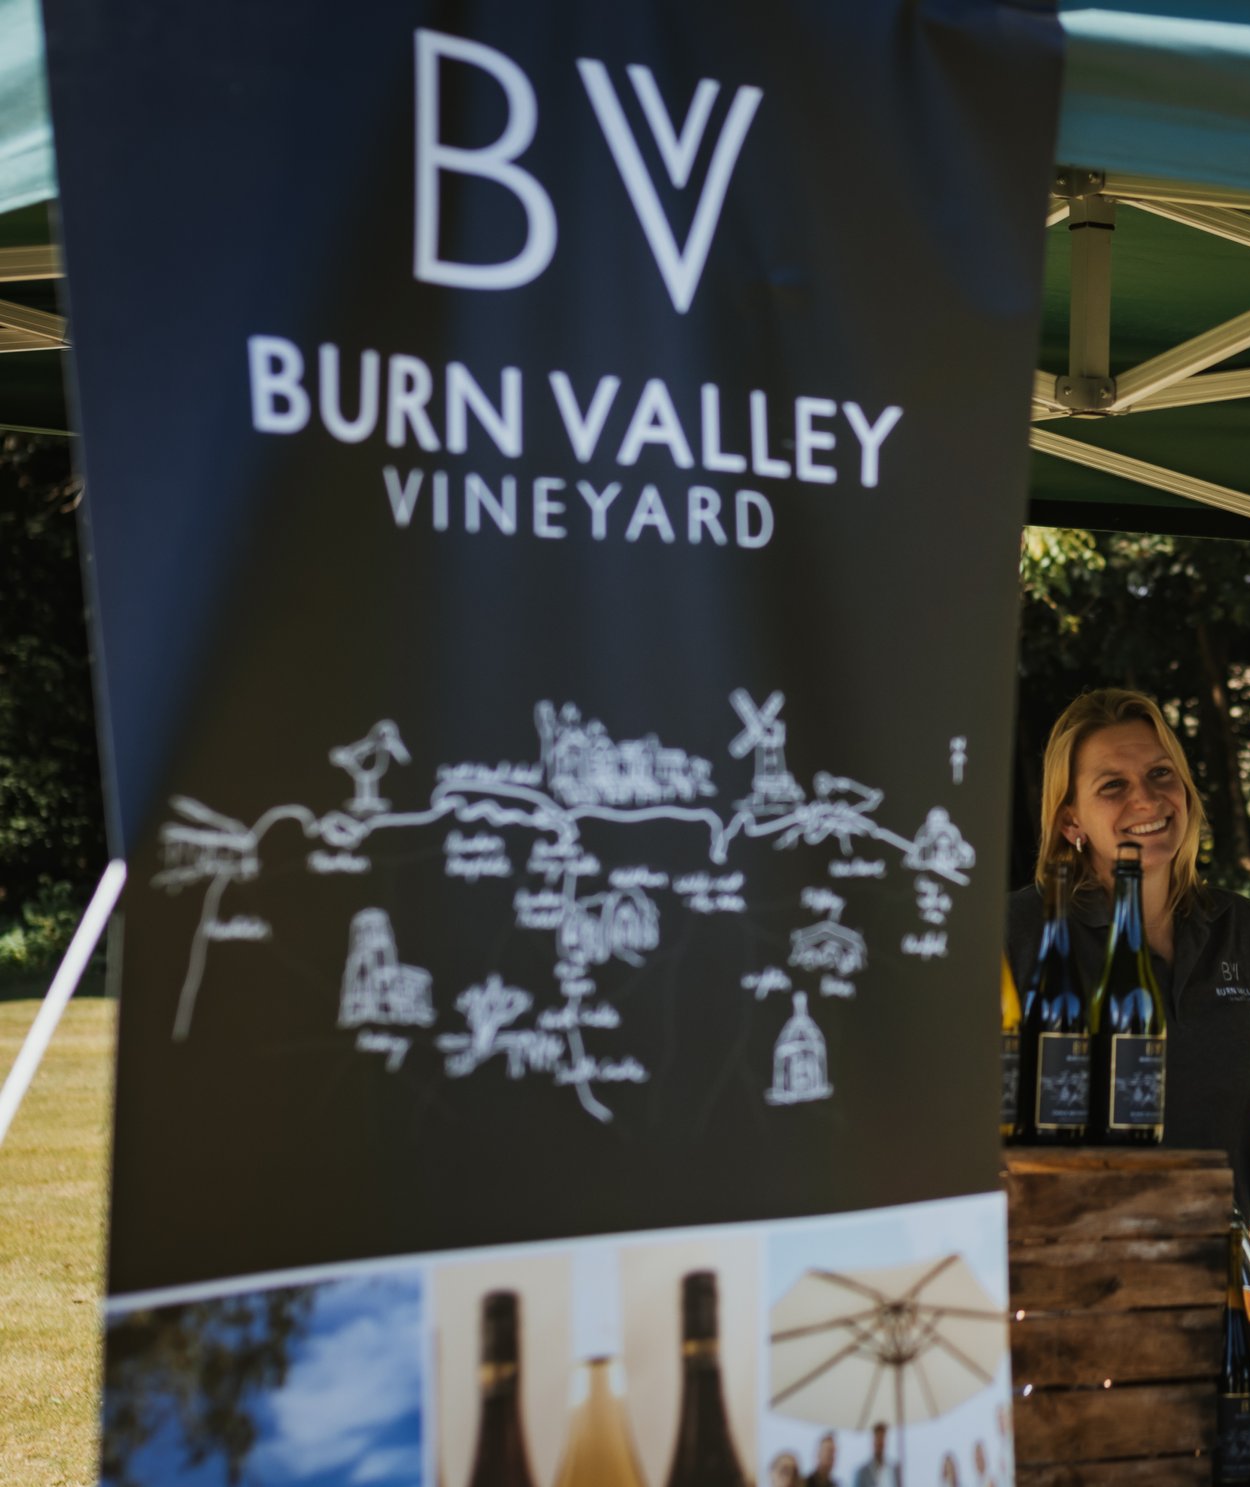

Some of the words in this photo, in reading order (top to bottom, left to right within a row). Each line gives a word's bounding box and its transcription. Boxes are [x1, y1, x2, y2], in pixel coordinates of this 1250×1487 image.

[414, 29, 764, 314] BV
[249, 336, 523, 459] BURN
[549, 371, 904, 489] VALLEY
[384, 468, 775, 549] VINEYARD
